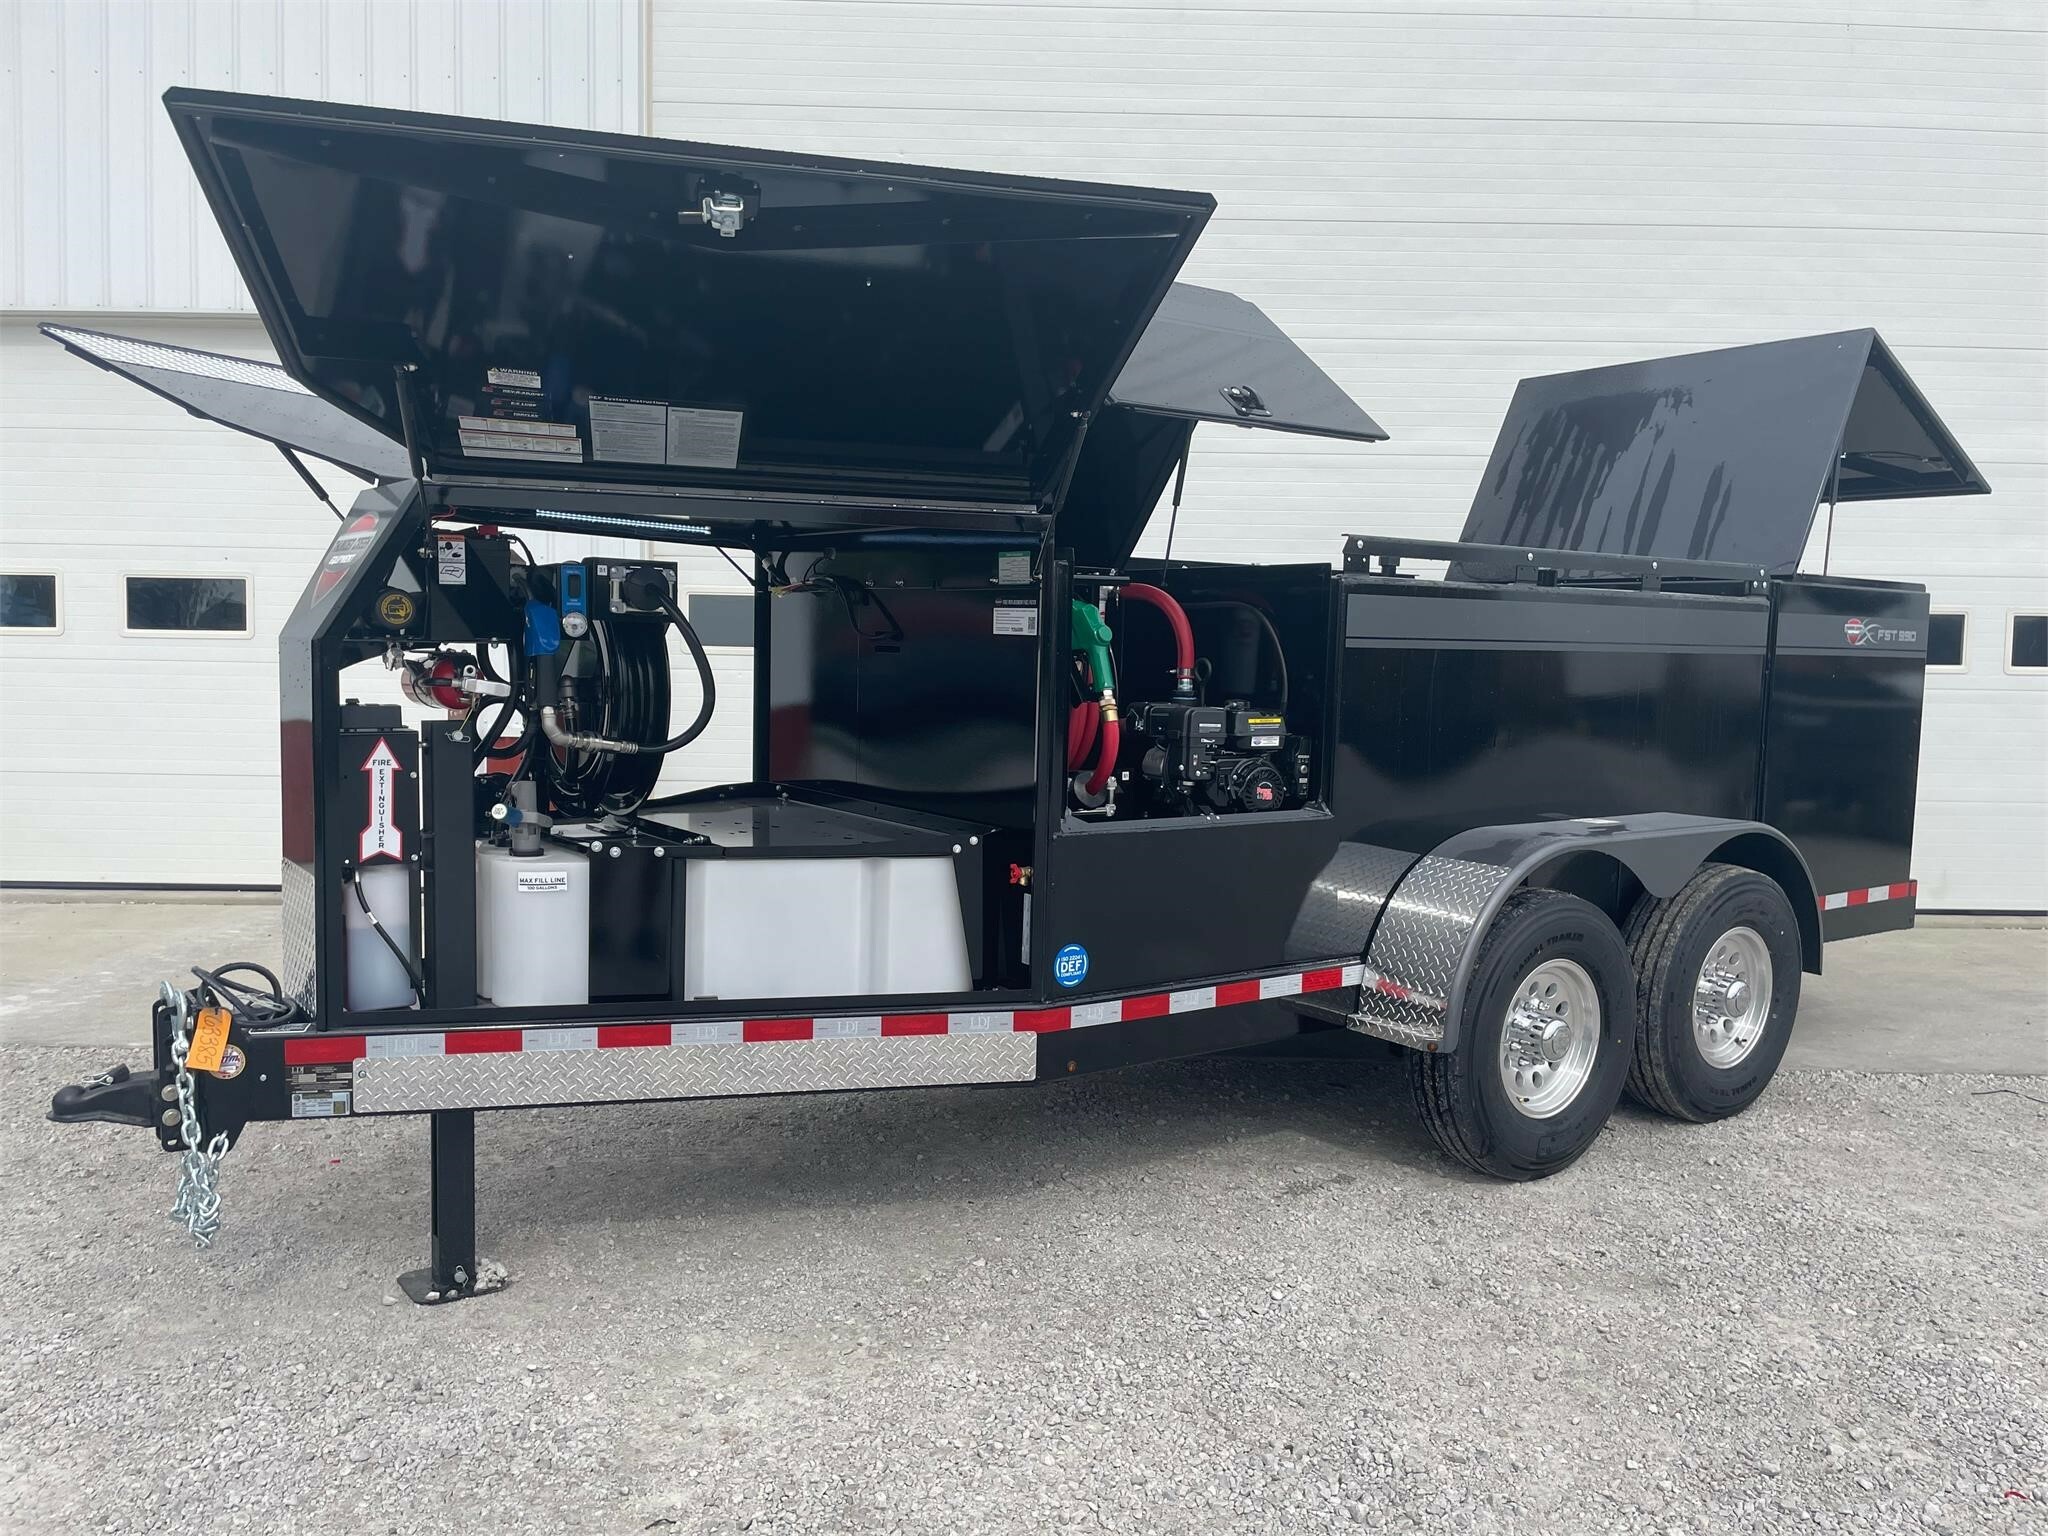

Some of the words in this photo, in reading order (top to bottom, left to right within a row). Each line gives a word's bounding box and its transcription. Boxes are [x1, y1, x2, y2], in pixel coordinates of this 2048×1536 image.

[499, 367, 538, 376] WARNING
[1877, 629, 1898, 641] FST
[378, 768, 386, 849] EXTINGUISHER
[1060, 960, 1083, 973] DEF
